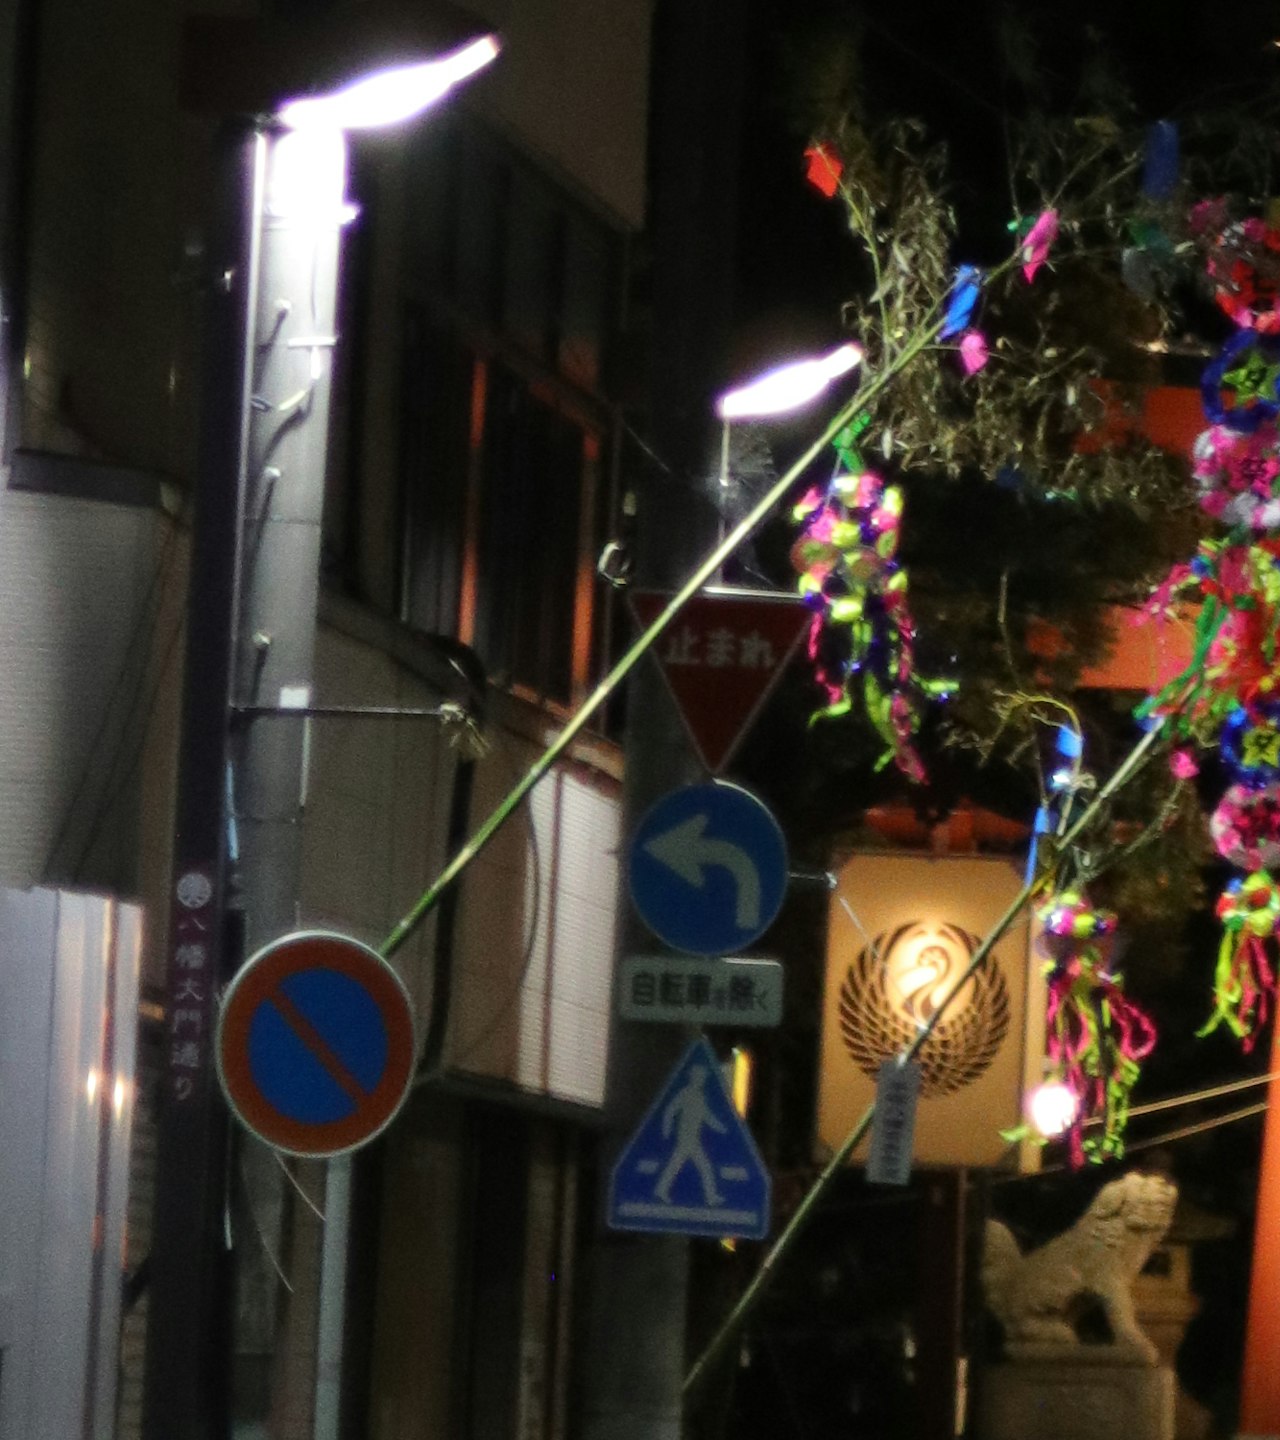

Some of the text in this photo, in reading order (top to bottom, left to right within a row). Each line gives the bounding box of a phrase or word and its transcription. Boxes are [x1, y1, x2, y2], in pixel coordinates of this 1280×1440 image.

[667, 627, 776, 669] 止まれ
[172, 918, 207, 1101] 八幡大門通り
